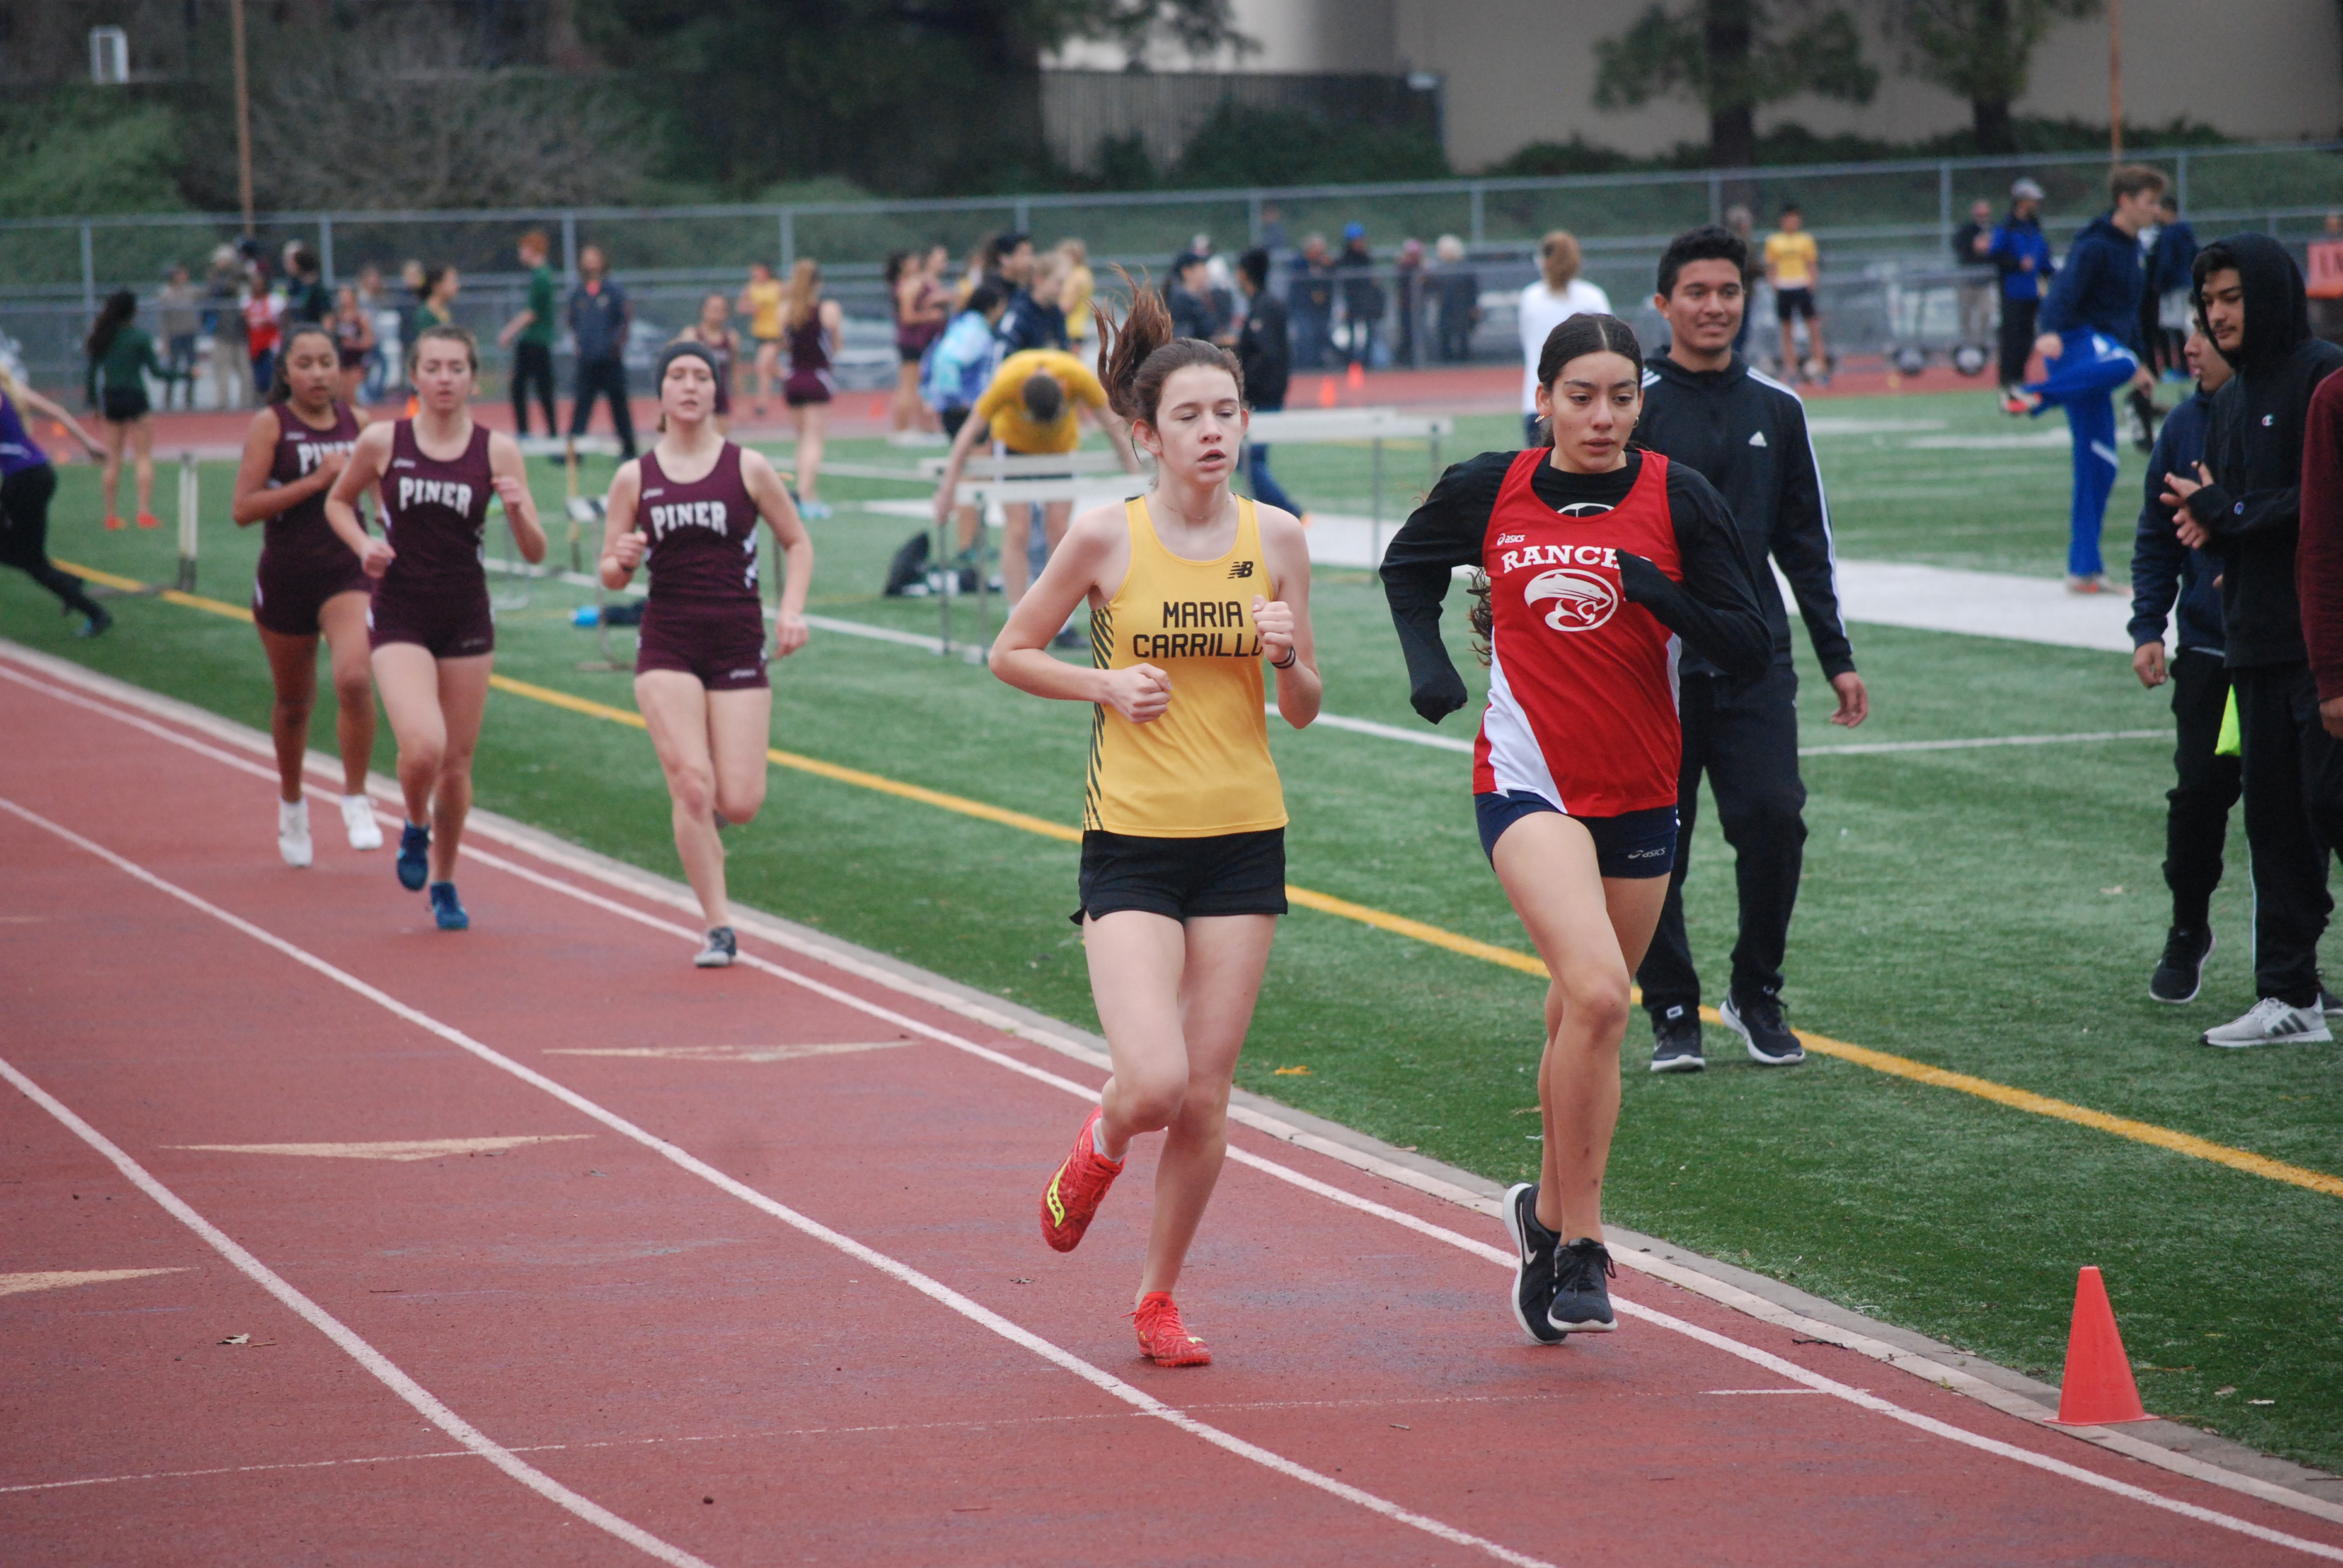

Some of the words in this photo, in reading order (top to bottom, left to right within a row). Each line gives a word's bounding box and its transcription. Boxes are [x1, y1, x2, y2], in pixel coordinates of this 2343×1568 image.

[399, 476, 473, 518] PINER
[650, 500, 727, 541] PINER
[1163, 601, 1244, 627] MARIA
